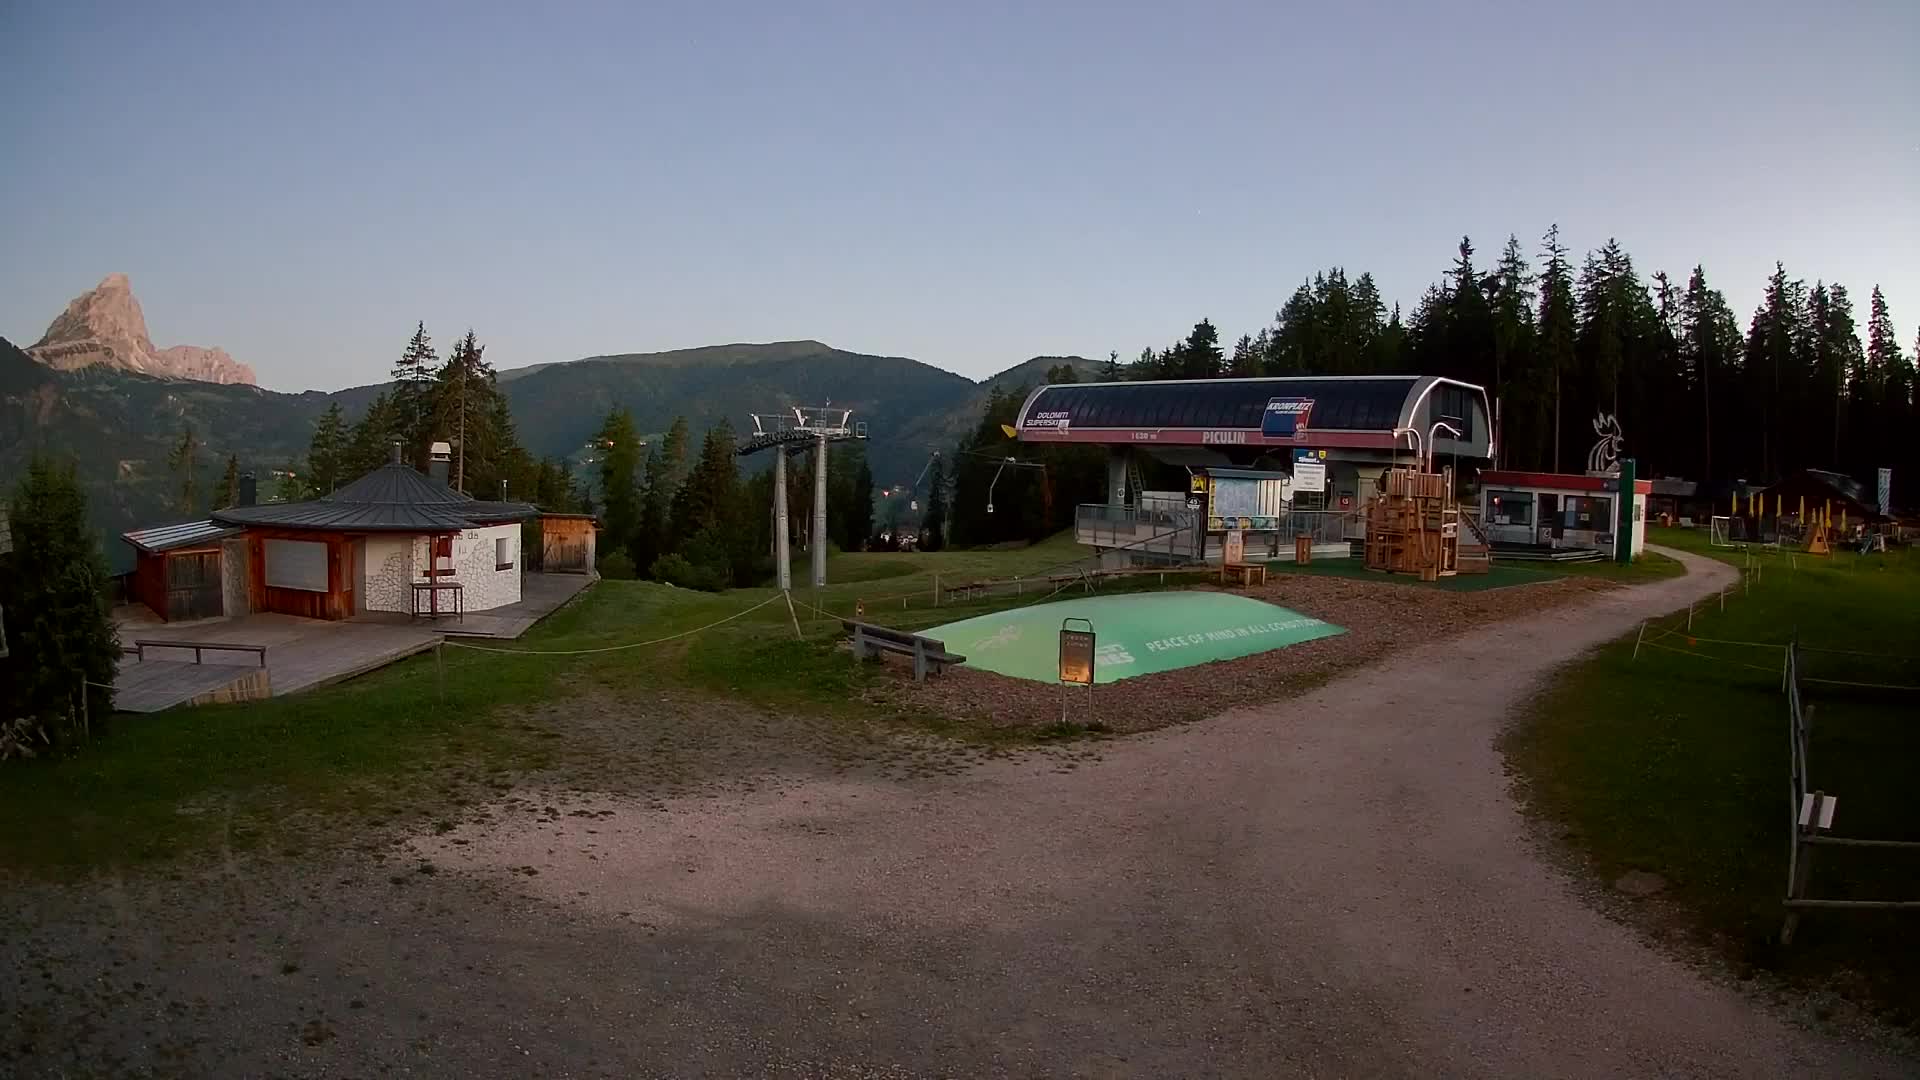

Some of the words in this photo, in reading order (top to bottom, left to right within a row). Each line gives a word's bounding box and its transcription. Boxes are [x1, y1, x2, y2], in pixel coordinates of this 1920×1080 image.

[1266, 402, 1313, 411] KRONPLATZ
[1037, 411, 1069, 419] DOLOMITI
[1202, 431, 1246, 444] PICULIN
[1145, 638, 1188, 652] PEACE
[1187, 633, 1206, 644] OF
[1206, 629, 1235, 641] MIND
[1234, 627, 1249, 638] IN
[1249, 623, 1269, 634] ALL
